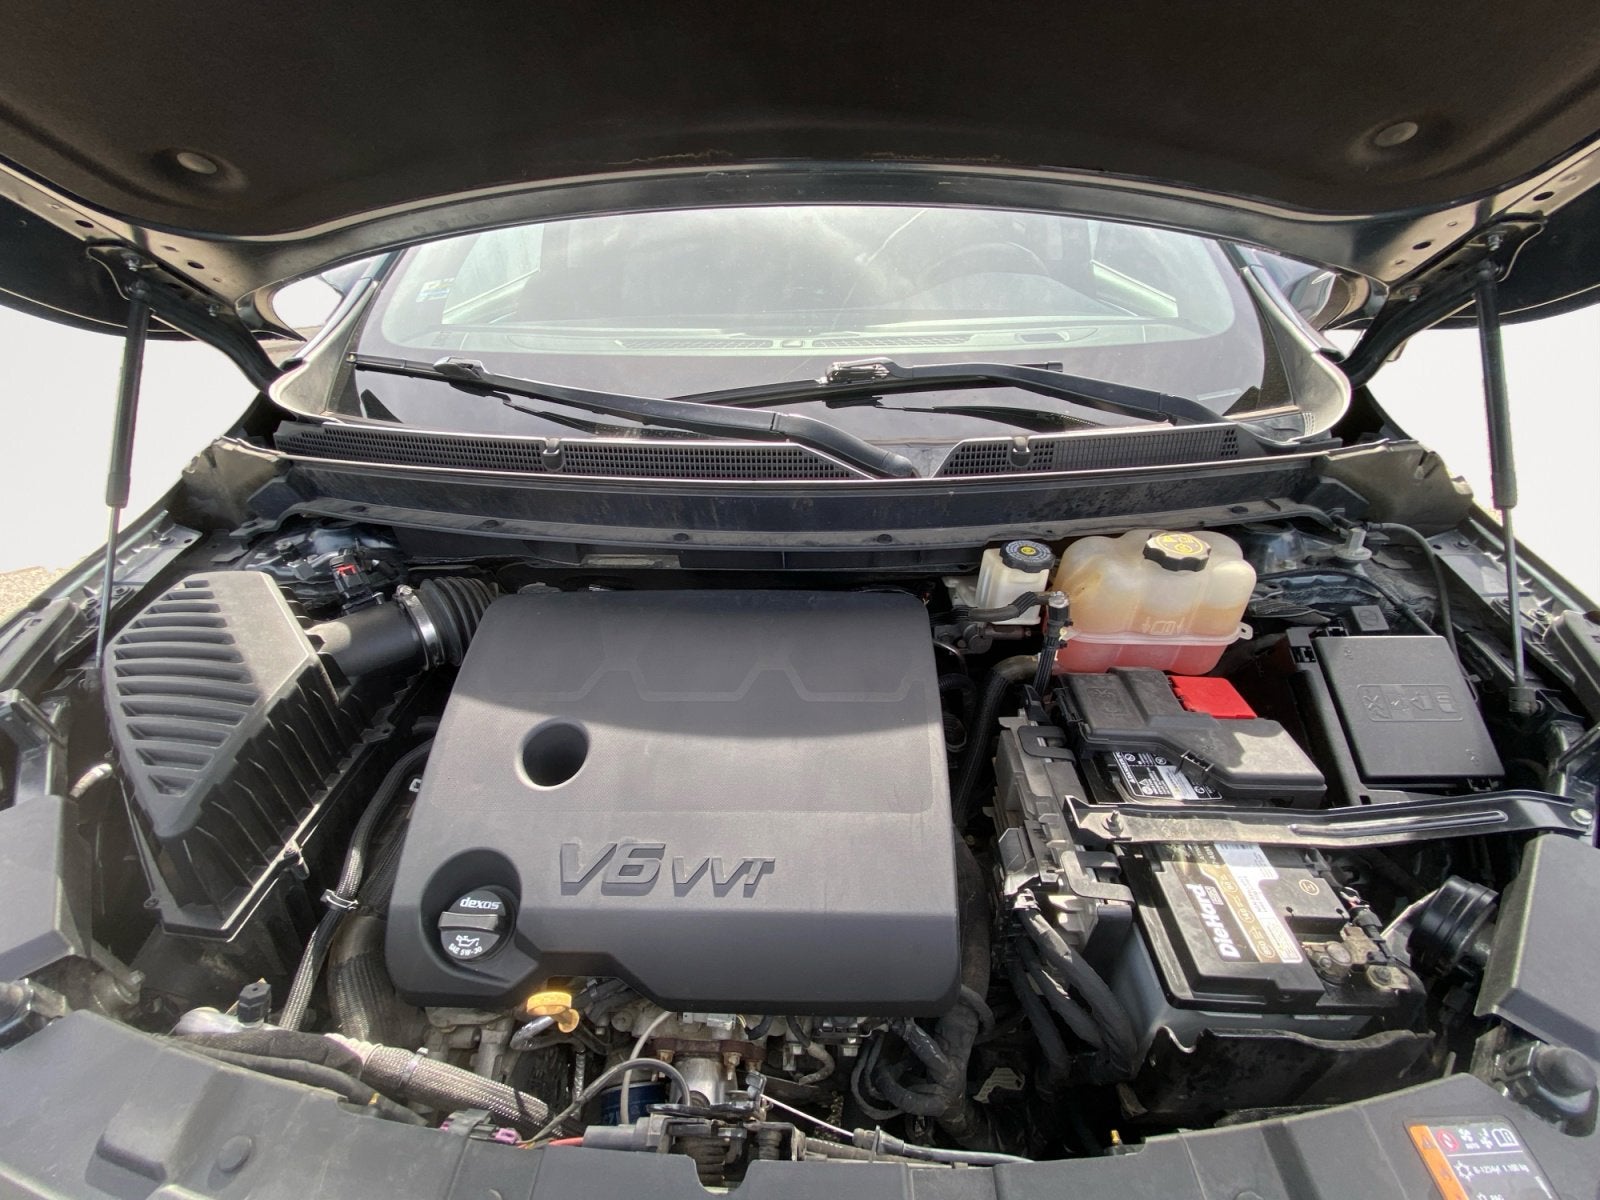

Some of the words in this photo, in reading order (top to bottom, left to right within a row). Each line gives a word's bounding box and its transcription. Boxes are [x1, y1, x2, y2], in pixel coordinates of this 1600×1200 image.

[560, 842, 666, 896] V6
[672, 856, 775, 898] VVT
[460, 897, 502, 909] dexos
[1185, 883, 1241, 957] DieHard
[460, 946, 482, 956] 5W-30
